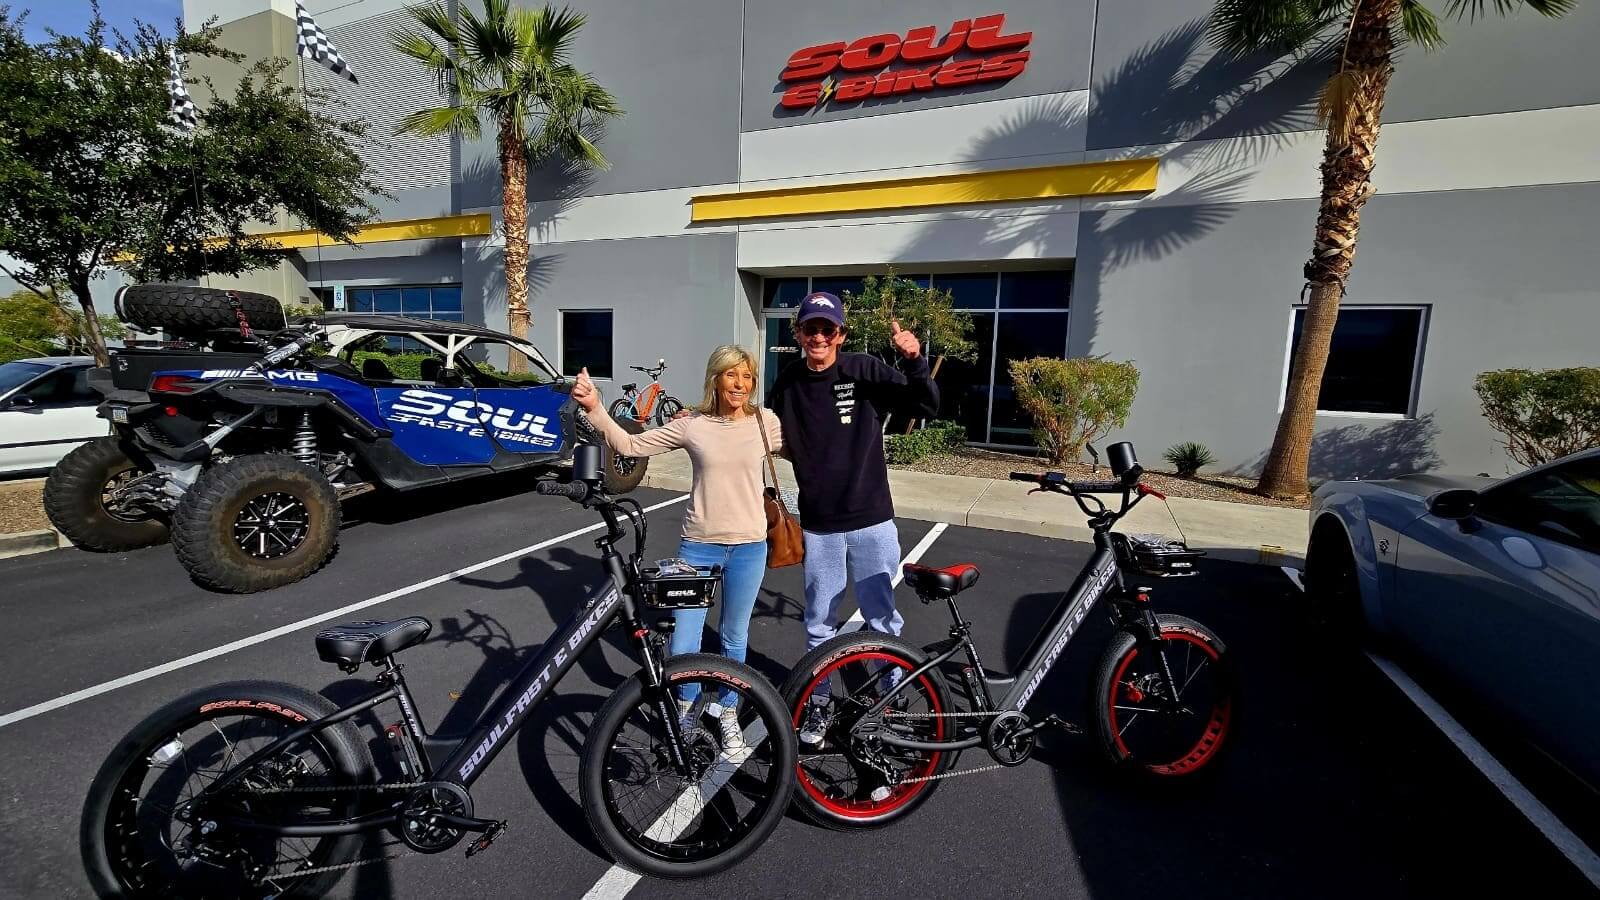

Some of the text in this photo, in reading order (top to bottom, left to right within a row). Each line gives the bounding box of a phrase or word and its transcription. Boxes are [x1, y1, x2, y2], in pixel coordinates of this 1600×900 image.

[781, 14, 1032, 82] SOUL
[781, 51, 1030, 108] E BIKES
[391, 389, 558, 439] SOUL
[497, 430, 555, 447] BIKES
[1016, 560, 1116, 712] SOULFAST E BIKES
[459, 588, 619, 781] SOULFAST E BIKES
